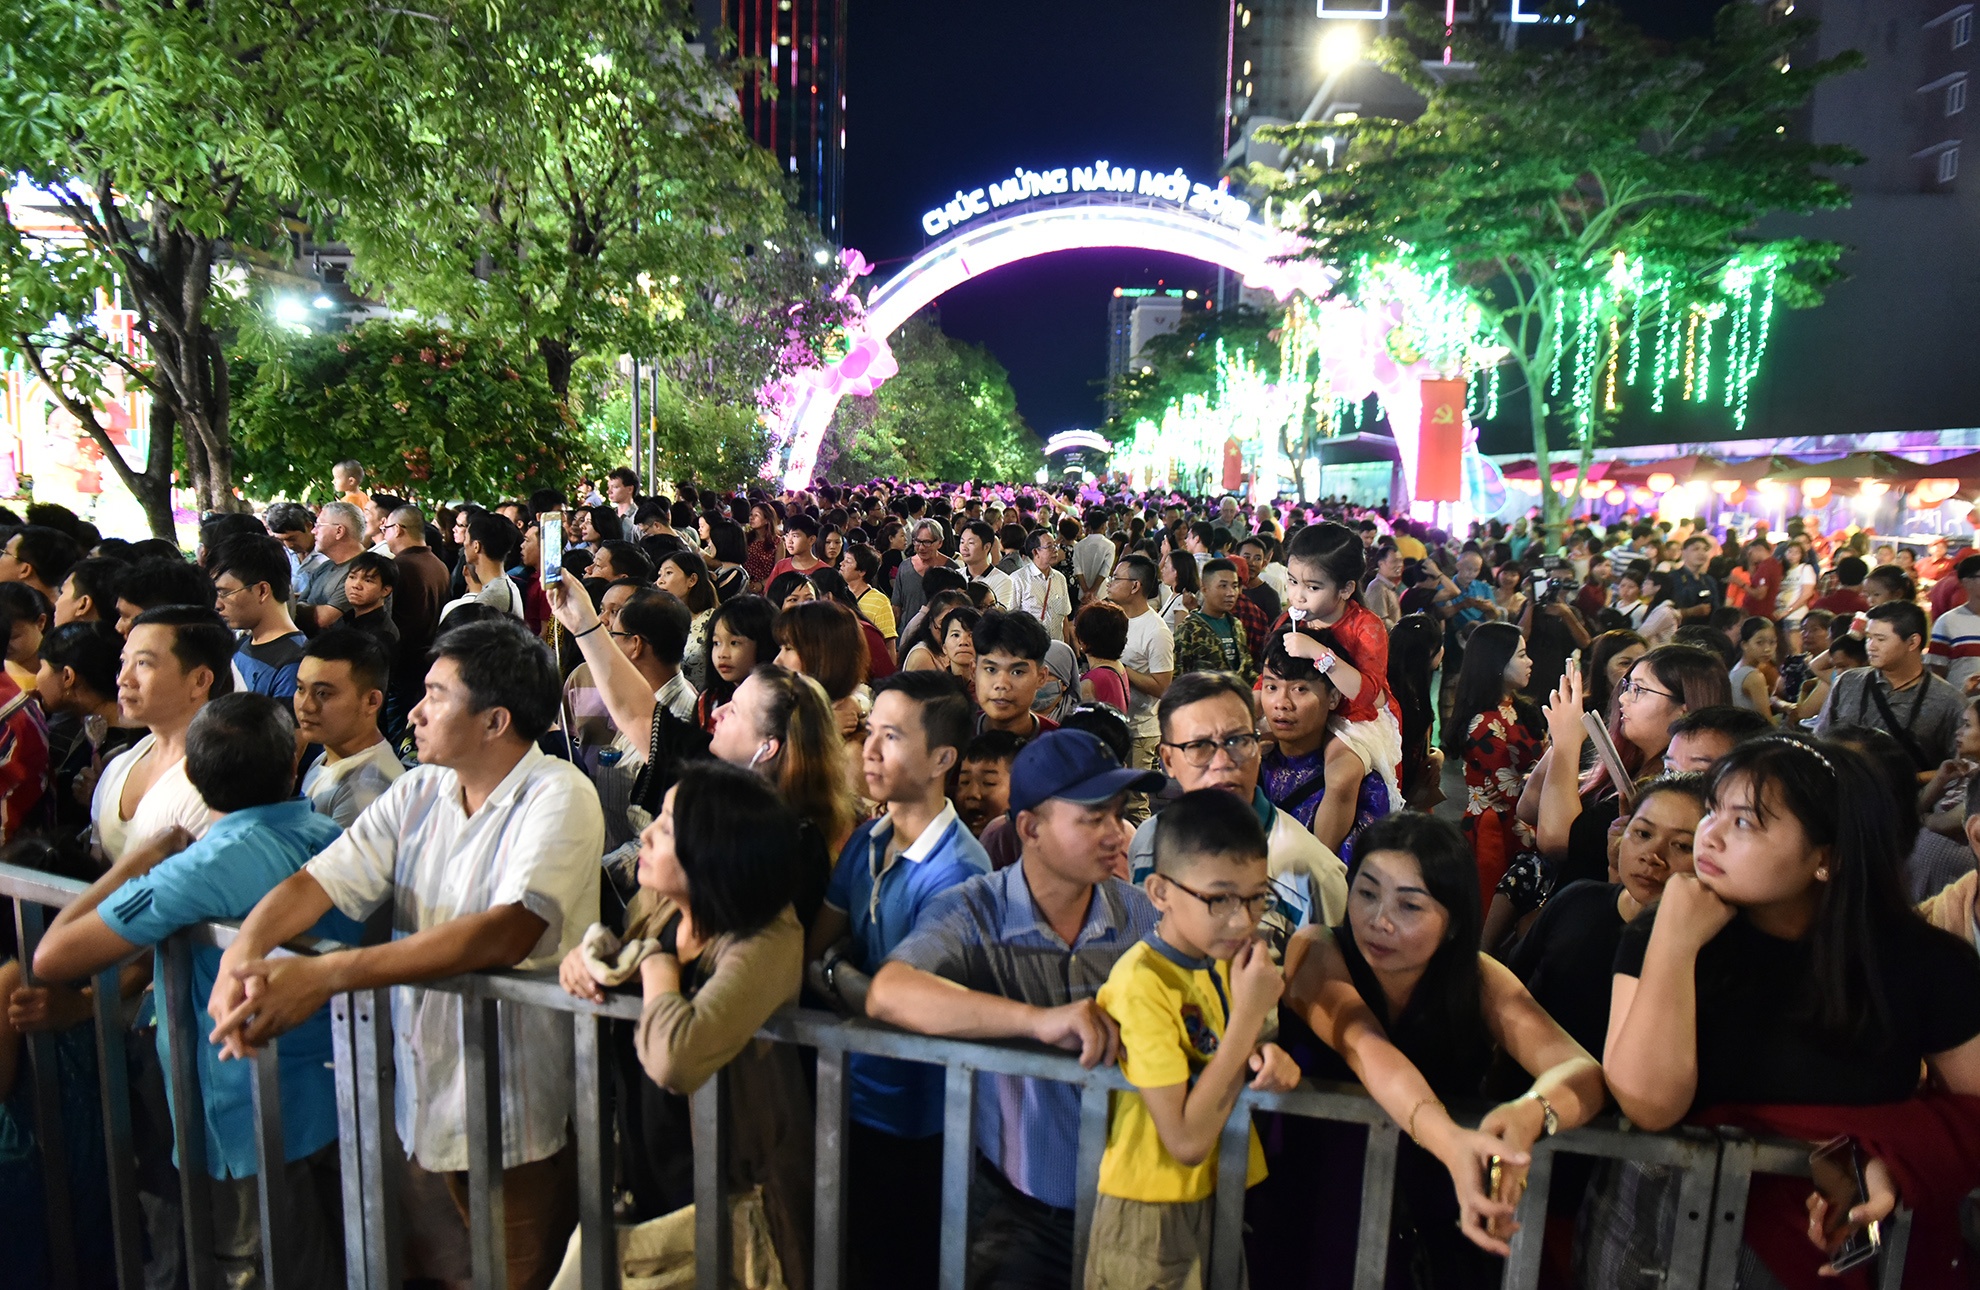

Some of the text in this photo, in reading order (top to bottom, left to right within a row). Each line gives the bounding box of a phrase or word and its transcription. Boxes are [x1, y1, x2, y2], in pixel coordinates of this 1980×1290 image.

[922, 190, 989, 236] CHÚC
[1071, 160, 1136, 193] NĂM
[1138, 167, 1191, 204] MỚI
